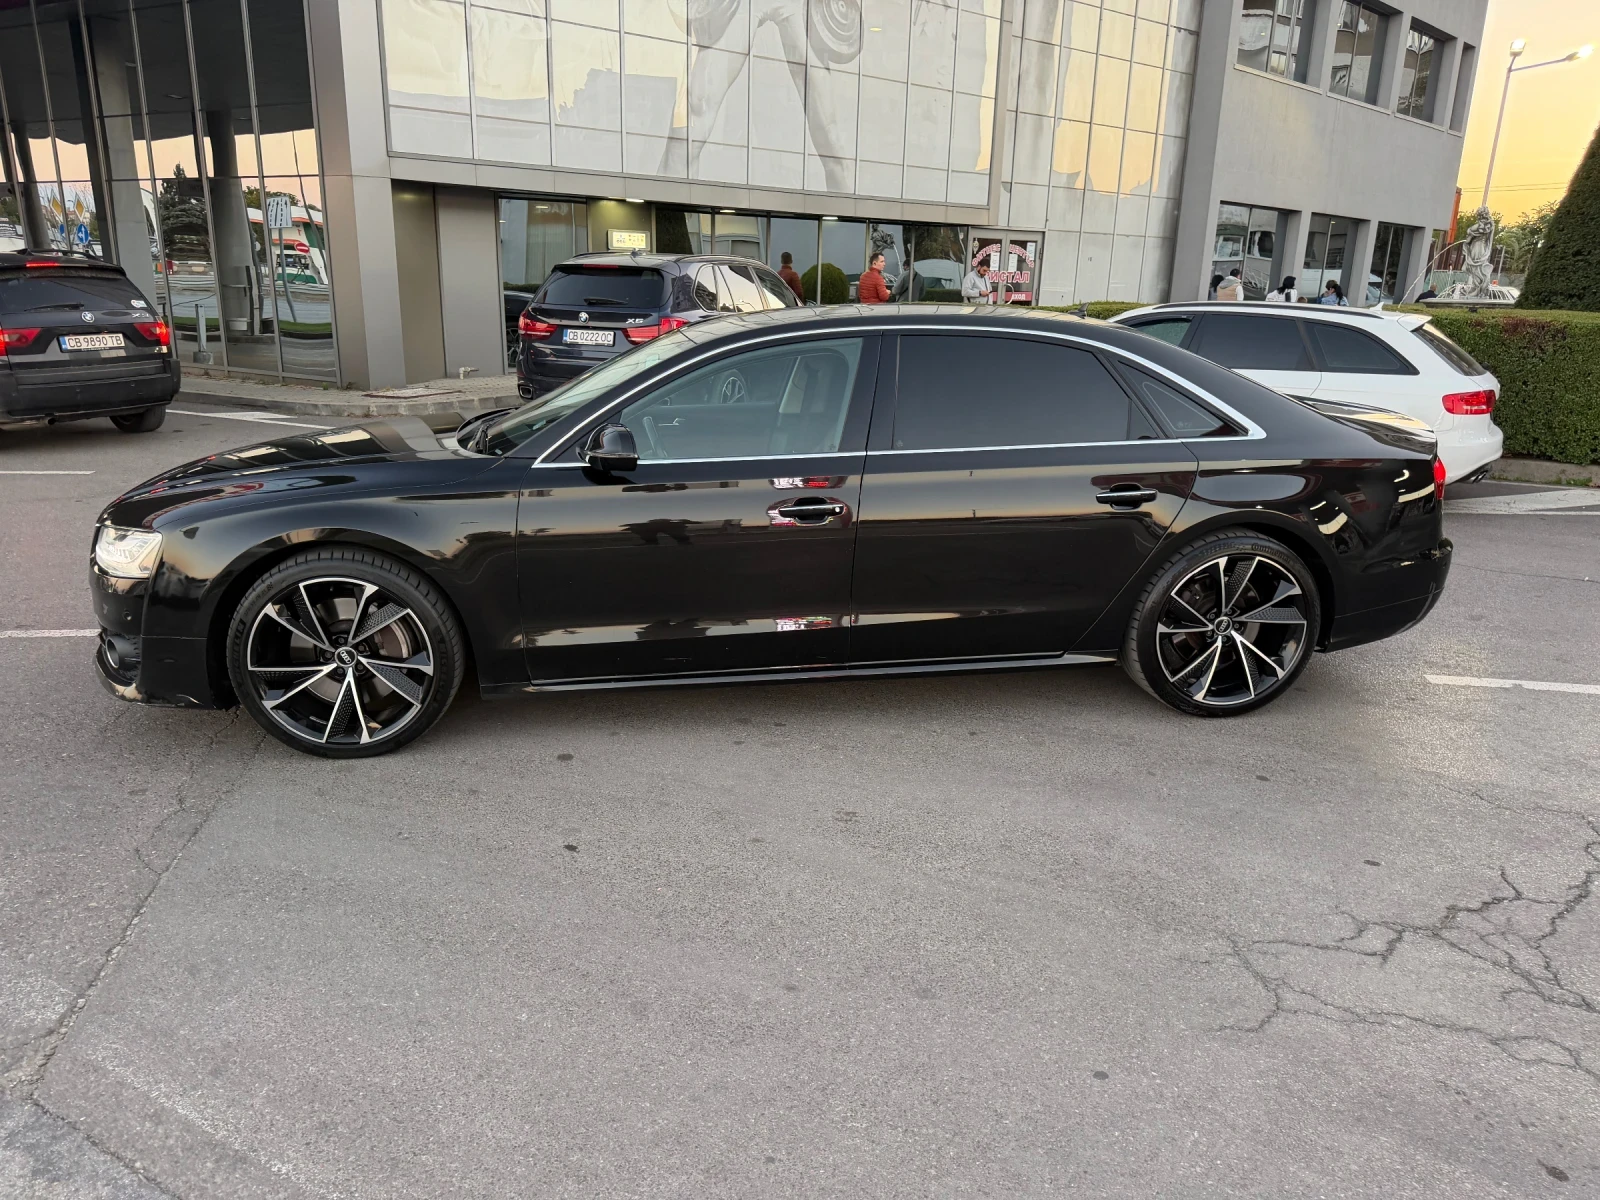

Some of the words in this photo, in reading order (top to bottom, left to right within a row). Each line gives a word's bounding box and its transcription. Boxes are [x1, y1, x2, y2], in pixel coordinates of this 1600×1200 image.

[986, 271, 1030, 283] ИСТАЛ
[83, 336, 108, 347] 9890
[580, 332, 600, 342] 0222
